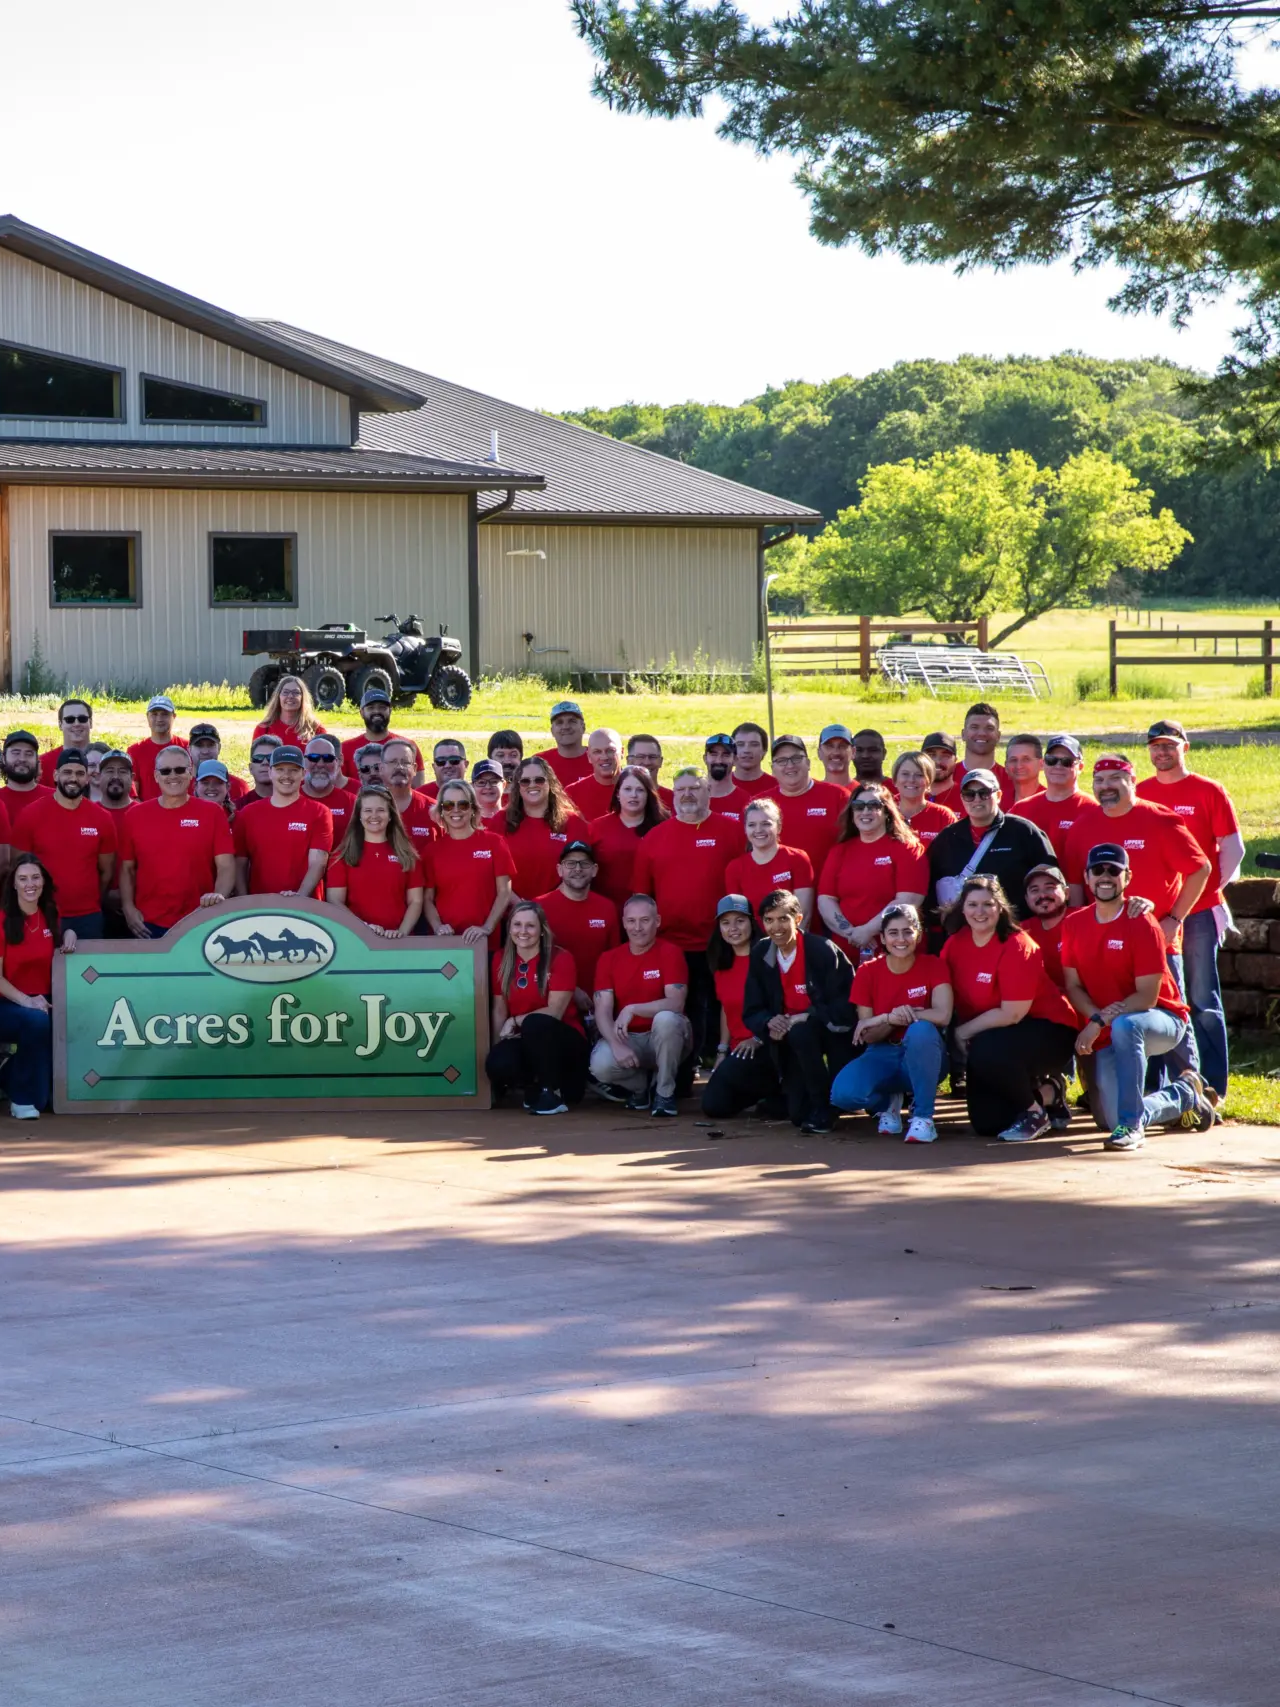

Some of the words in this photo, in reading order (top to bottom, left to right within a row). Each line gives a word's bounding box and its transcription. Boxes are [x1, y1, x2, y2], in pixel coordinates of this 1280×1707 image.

[96, 996, 250, 1047] Acres
[267, 993, 348, 1044] for
[355, 993, 450, 1059] Joy
